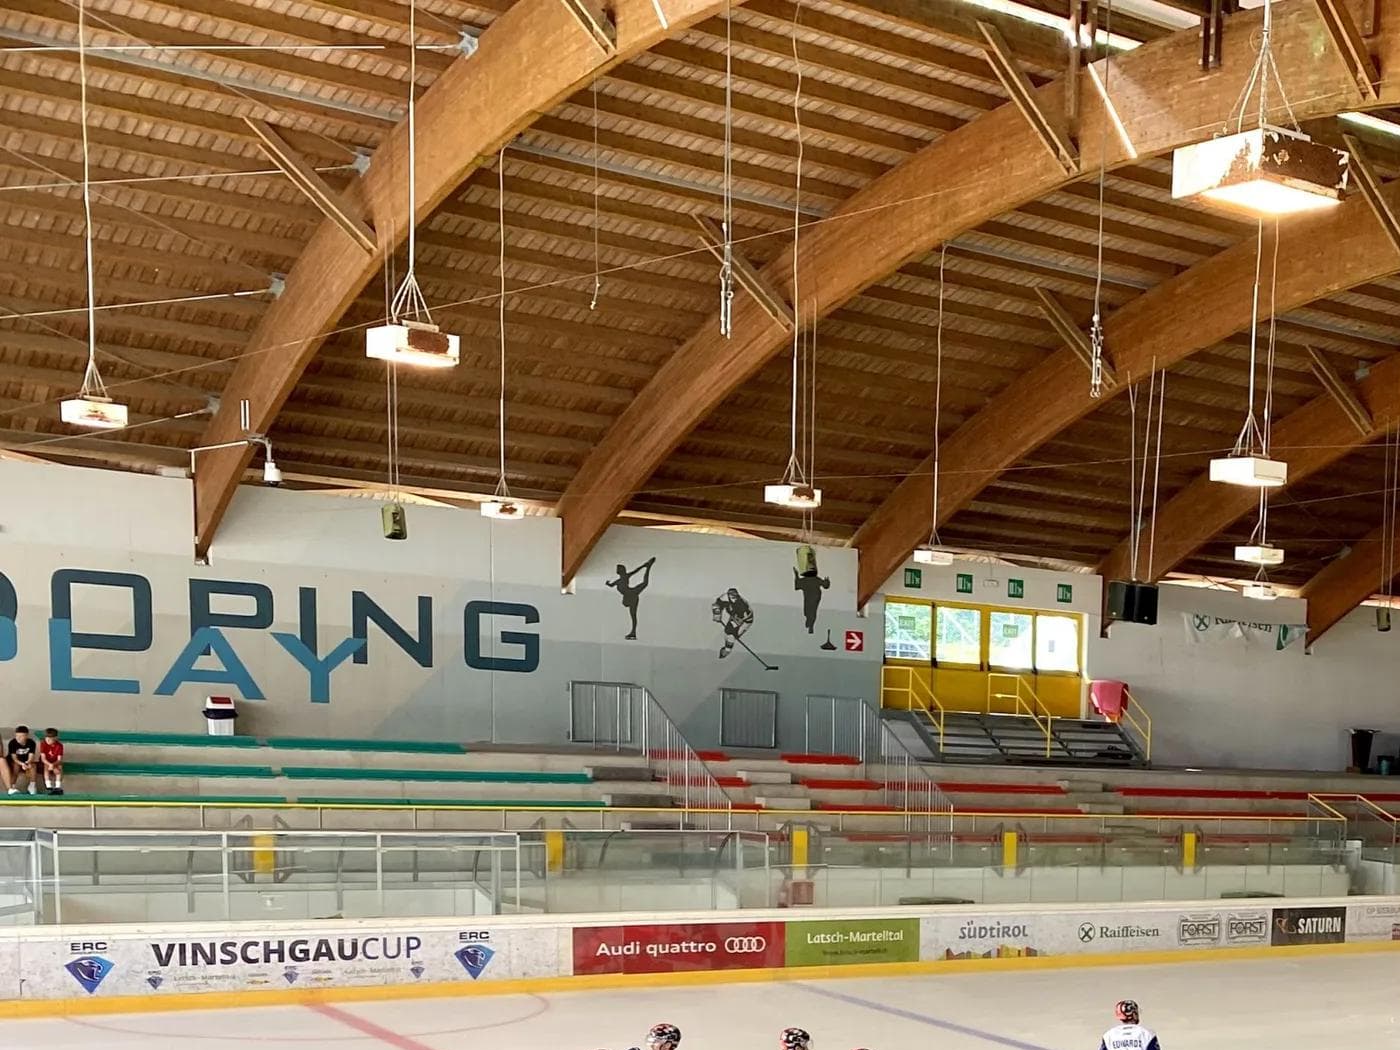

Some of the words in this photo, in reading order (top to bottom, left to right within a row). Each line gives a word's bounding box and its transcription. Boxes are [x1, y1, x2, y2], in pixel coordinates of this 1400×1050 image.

[0, 568, 540, 673] OPING
[0, 615, 367, 704] LAY
[1100, 925, 1160, 939] Raiffeisen
[1181, 922, 1216, 937] FORST
[1230, 921, 1264, 935] FORST
[1297, 916, 1342, 935] SATURN
[459, 931, 490, 940] ERC
[807, 929, 904, 944] Latsch-Martelltal
[70, 942, 108, 951] ERC
[151, 936, 422, 967] VINSCHGAUCUP
[596, 942, 640, 957] Audi
[646, 939, 717, 958] quattro
